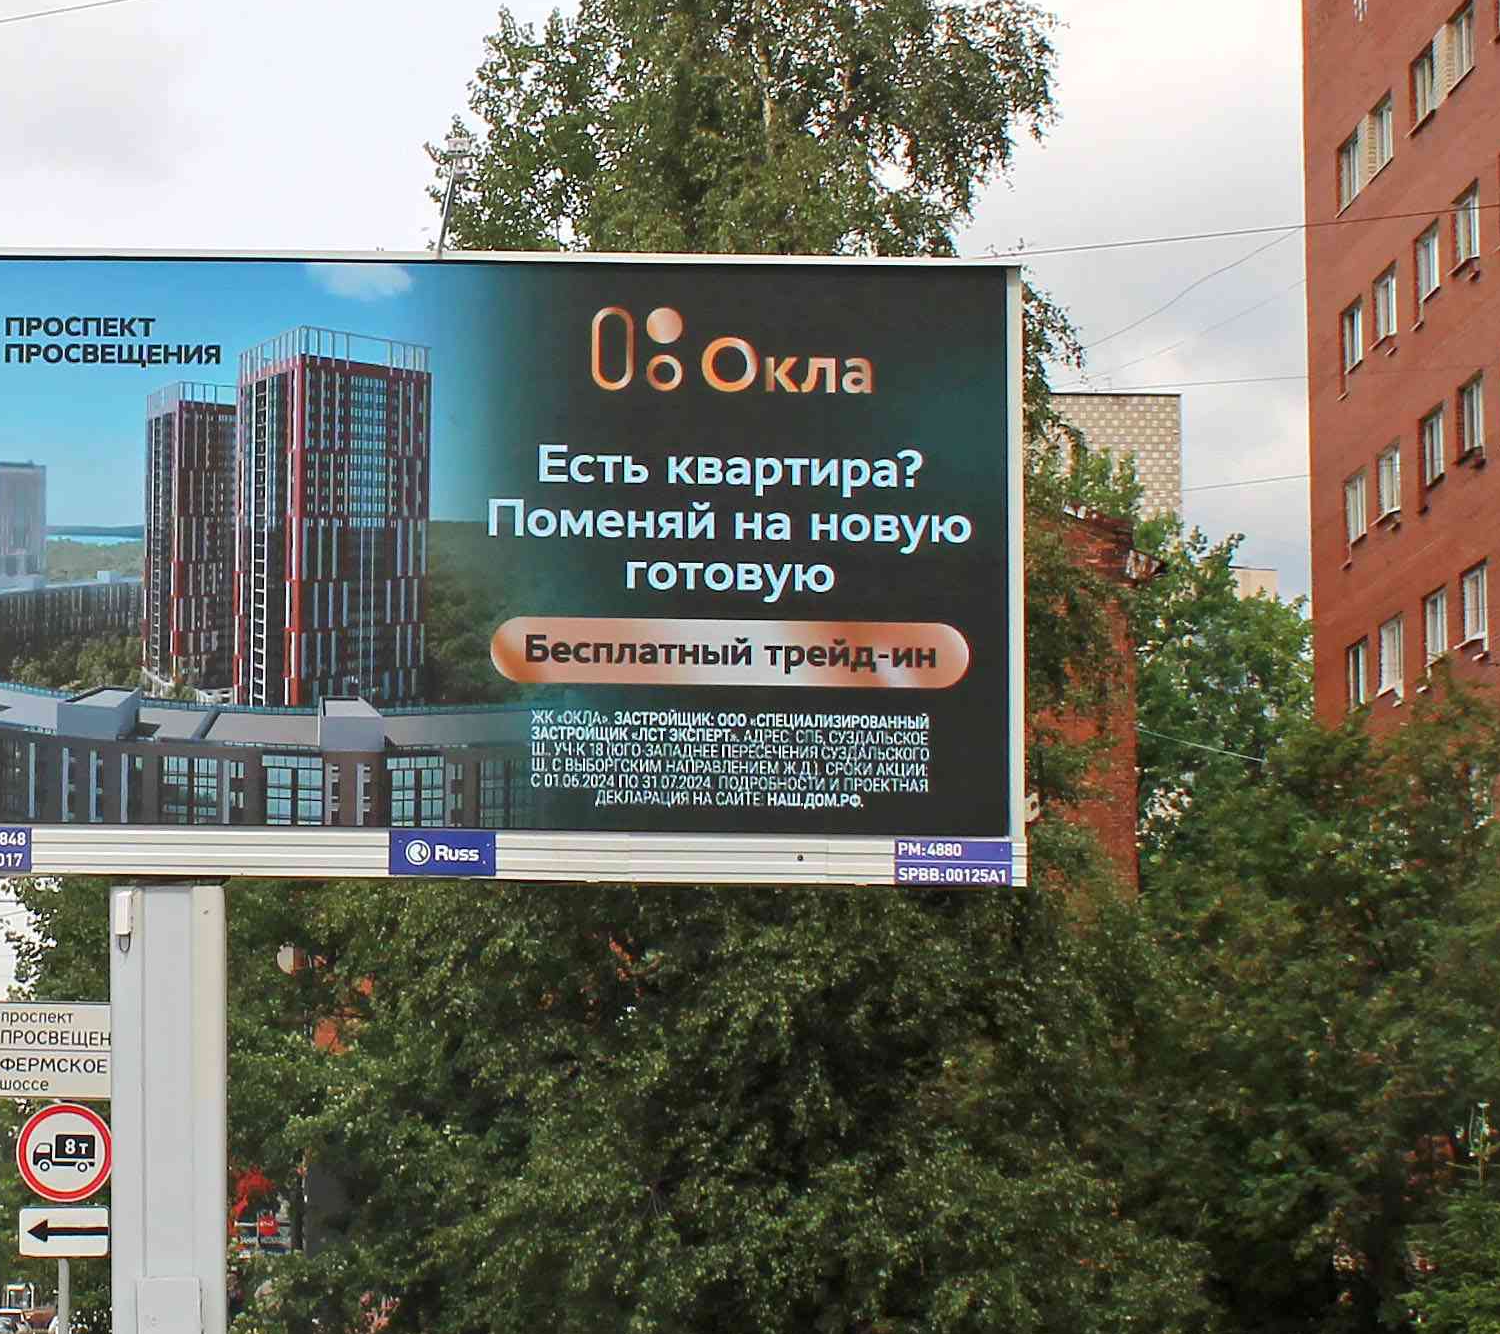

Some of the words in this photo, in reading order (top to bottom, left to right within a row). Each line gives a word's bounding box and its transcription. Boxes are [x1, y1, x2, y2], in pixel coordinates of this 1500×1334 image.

[5, 317, 155, 337] ПРОСПЕКТ
[4, 344, 221, 368] ПРОСВЕЩЕНИЯ
[701, 336, 874, 394] Окла
[537, 443, 648, 485] Есть
[667, 449, 923, 498] квартира?
[487, 498, 715, 540] Поменяй
[735, 512, 791, 542] на
[811, 513, 972, 554] новую
[626, 560, 835, 603] готовую
[525, 634, 752, 667] Бесплатный
[766, 638, 937, 675] трейд-ин
[531, 710, 554, 725] ЖК
[614, 710, 714, 729] ЗАСТРОЙЩИК:
[718, 713, 747, 727] ООО
[750, 713, 929, 730] «СПЕЦИАЛИЗИРОВАННЫЙ
[531, 725, 628, 743] ЗАСТРОЙЩИК
[829, 731, 928, 748] СУЗДАЛЬСКОЕ
[591, 744, 604, 757] 18
[722, 744, 819, 760] ПЕРЕСЕЧЕНИЯ
[821, 746, 929, 765] СУЗДАЛЬСКОГО
[552, 759, 562, 772] С
[565, 758, 661, 773] ВЫБОРГСКИМ
[666, 759, 779, 775] НАПРАВЛЕНИЕМ
[826, 762, 873, 776] СРОКИ
[530, 773, 541, 788] С
[619, 775, 638, 789] ПО
[718, 776, 825, 793] ПОДРОБНОСТИ
[830, 778, 839, 791] И
[844, 778, 929, 793] ПРОЕКТНАЯ
[595, 790, 690, 808] ДЕКЛАРАЦИЯ
[693, 792, 712, 805] НА
[434, 844, 481, 862] Russ
[898, 868, 1006, 884] SPBB:00125A1
[1, 1011, 74, 1026] проспект
[0, 1029, 111, 1048] ПРОСВЕЩЕН
[0, 1057, 107, 1074] ФЕРМСКОЕ
[0, 1079, 49, 1091] шоссе
